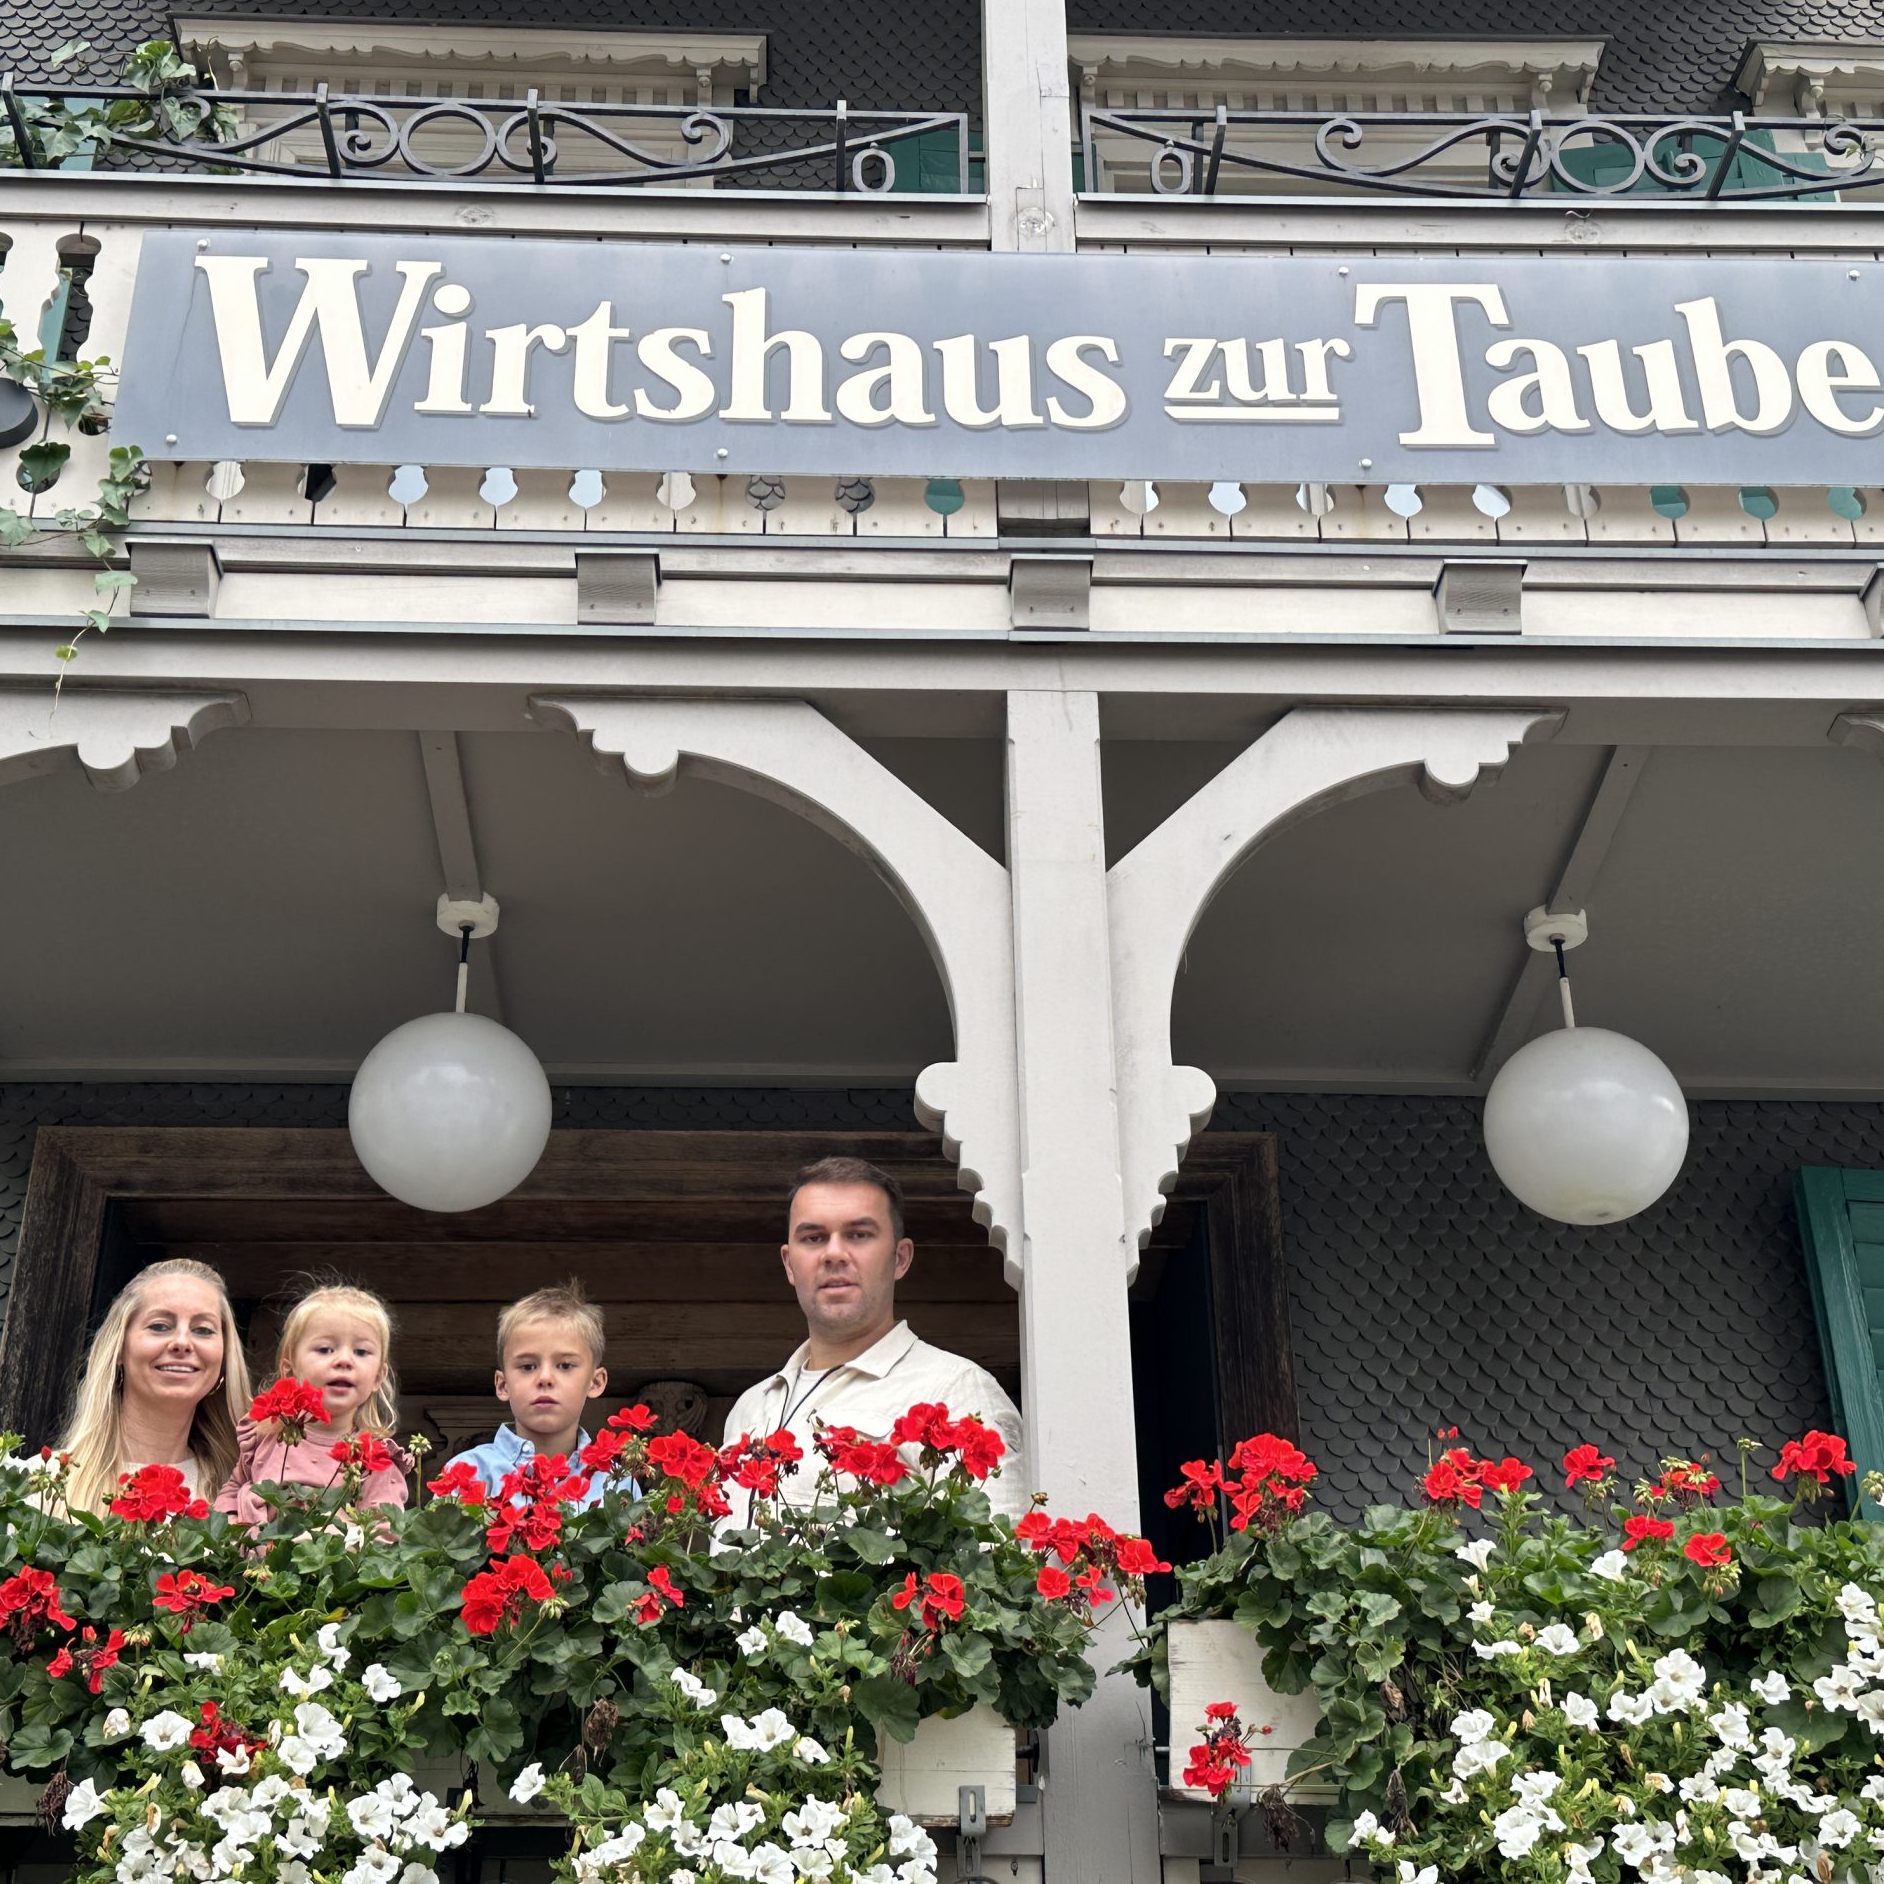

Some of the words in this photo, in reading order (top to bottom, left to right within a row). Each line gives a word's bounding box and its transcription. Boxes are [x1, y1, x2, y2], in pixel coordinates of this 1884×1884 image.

[195, 254, 1128, 430] Wirtshaus
[1163, 336, 1351, 401] zur
[1354, 283, 1884, 446] Taube
